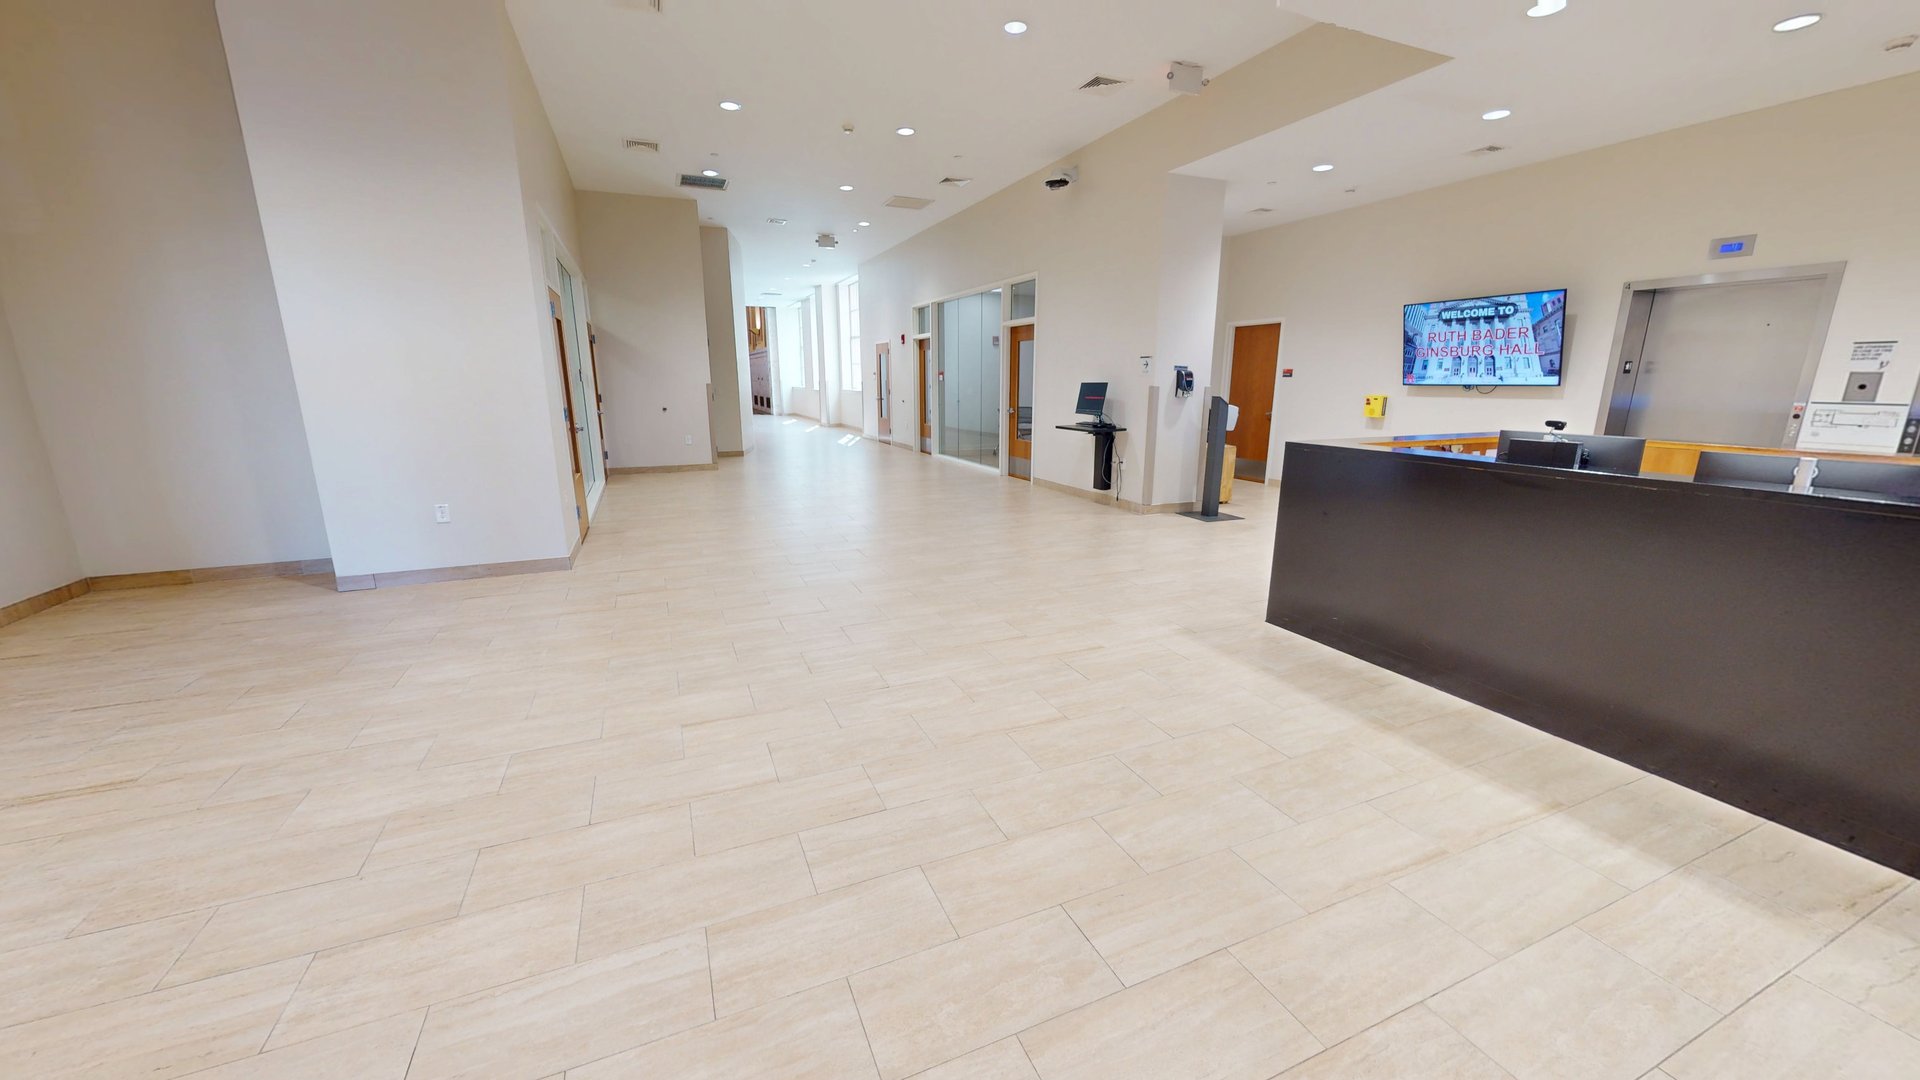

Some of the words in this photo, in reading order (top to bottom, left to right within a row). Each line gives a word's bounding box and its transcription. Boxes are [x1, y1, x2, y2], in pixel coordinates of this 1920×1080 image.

[1442, 308, 1495, 319] WELCOME
[1498, 305, 1514, 315] TO
[1428, 331, 1467, 342] RUTH
[1472, 327, 1529, 340] BADER
[1416, 346, 1493, 357] GINSBURG
[1500, 343, 1545, 355] HALL
